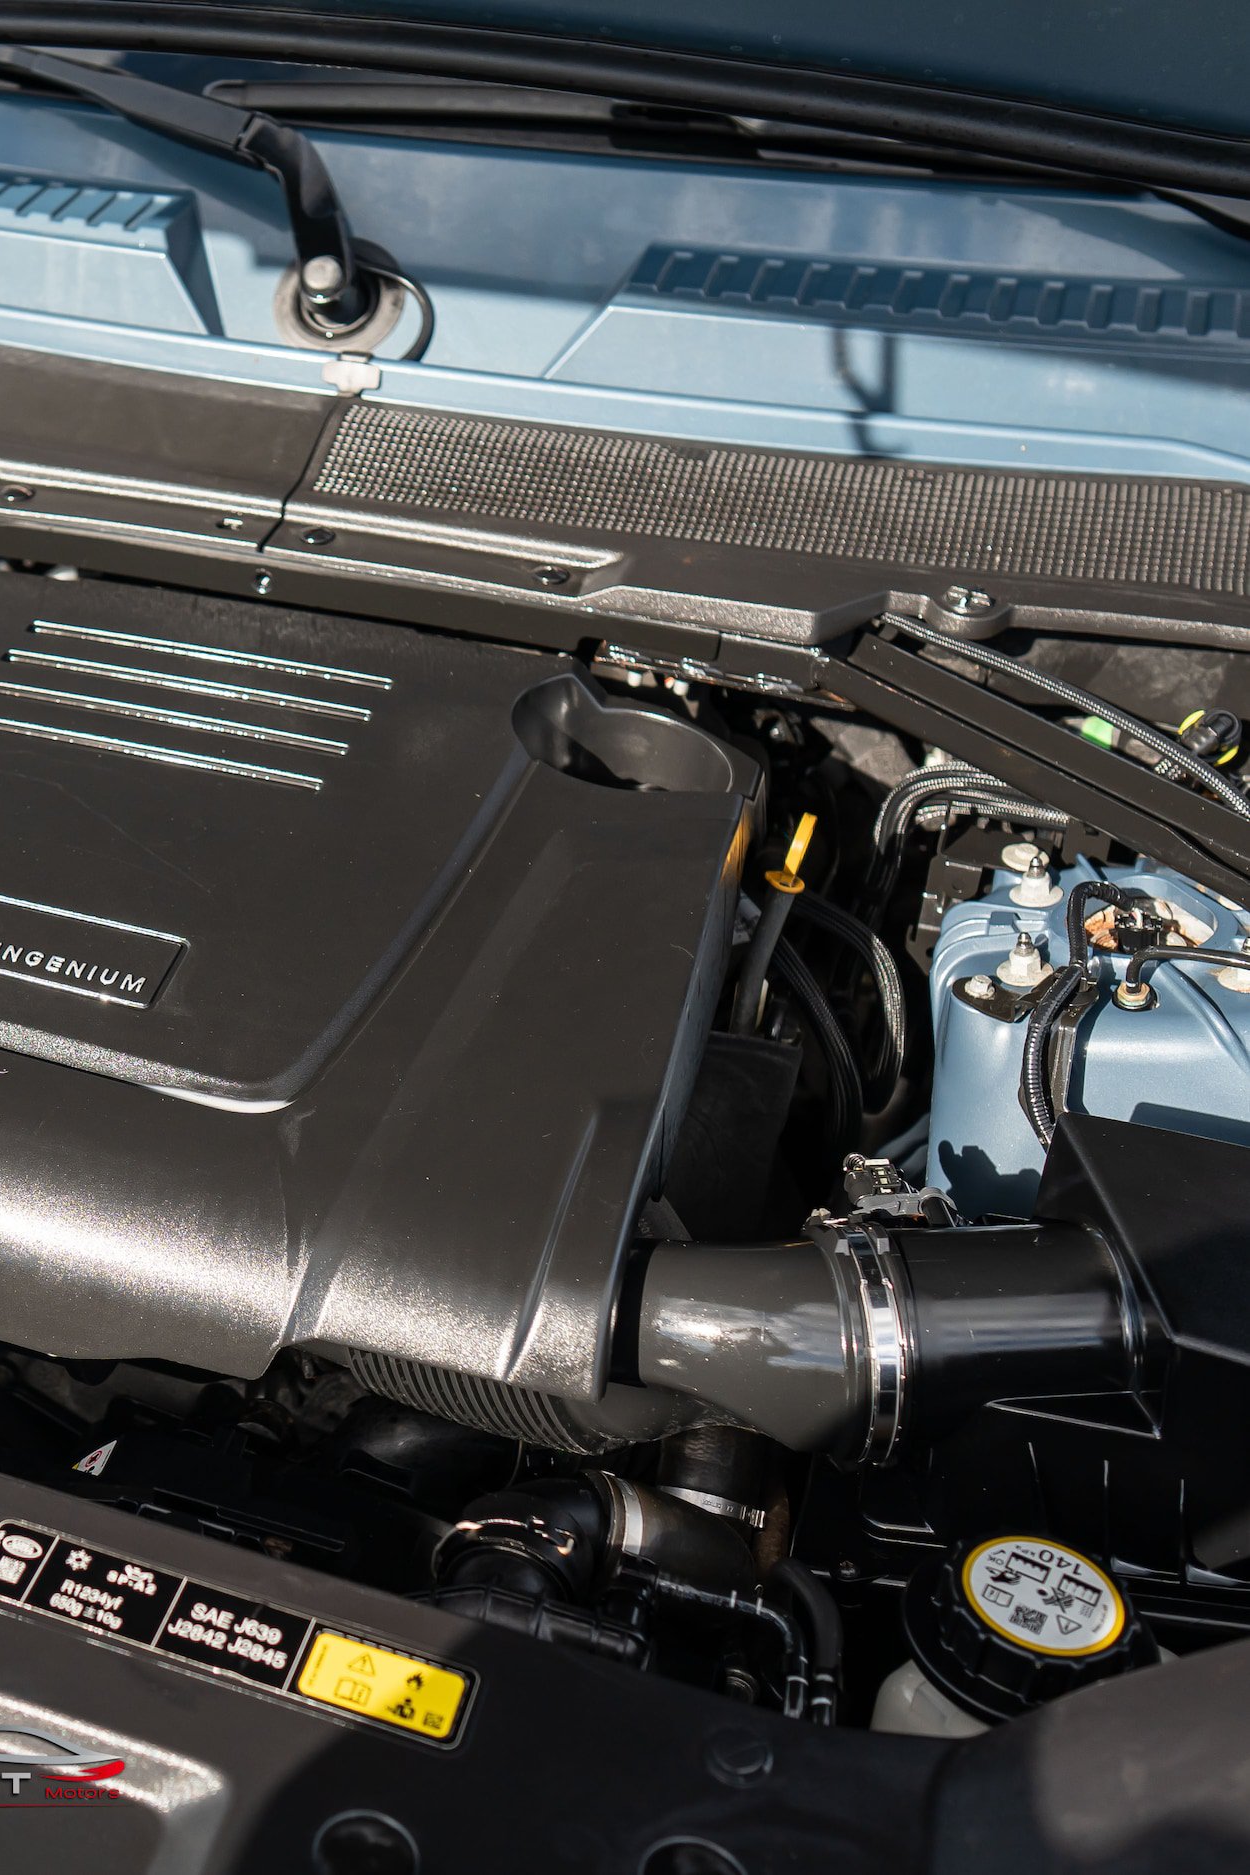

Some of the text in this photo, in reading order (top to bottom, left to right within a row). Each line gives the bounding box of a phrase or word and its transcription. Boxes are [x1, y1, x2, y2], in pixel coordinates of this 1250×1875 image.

[1038, 1549, 1083, 1576] 140
[59, 1578, 125, 1611] R1234yf
[190, 1602, 283, 1646] SAE J639
[167, 1617, 228, 1650] J2842
[227, 1635, 289, 1670] J2845
